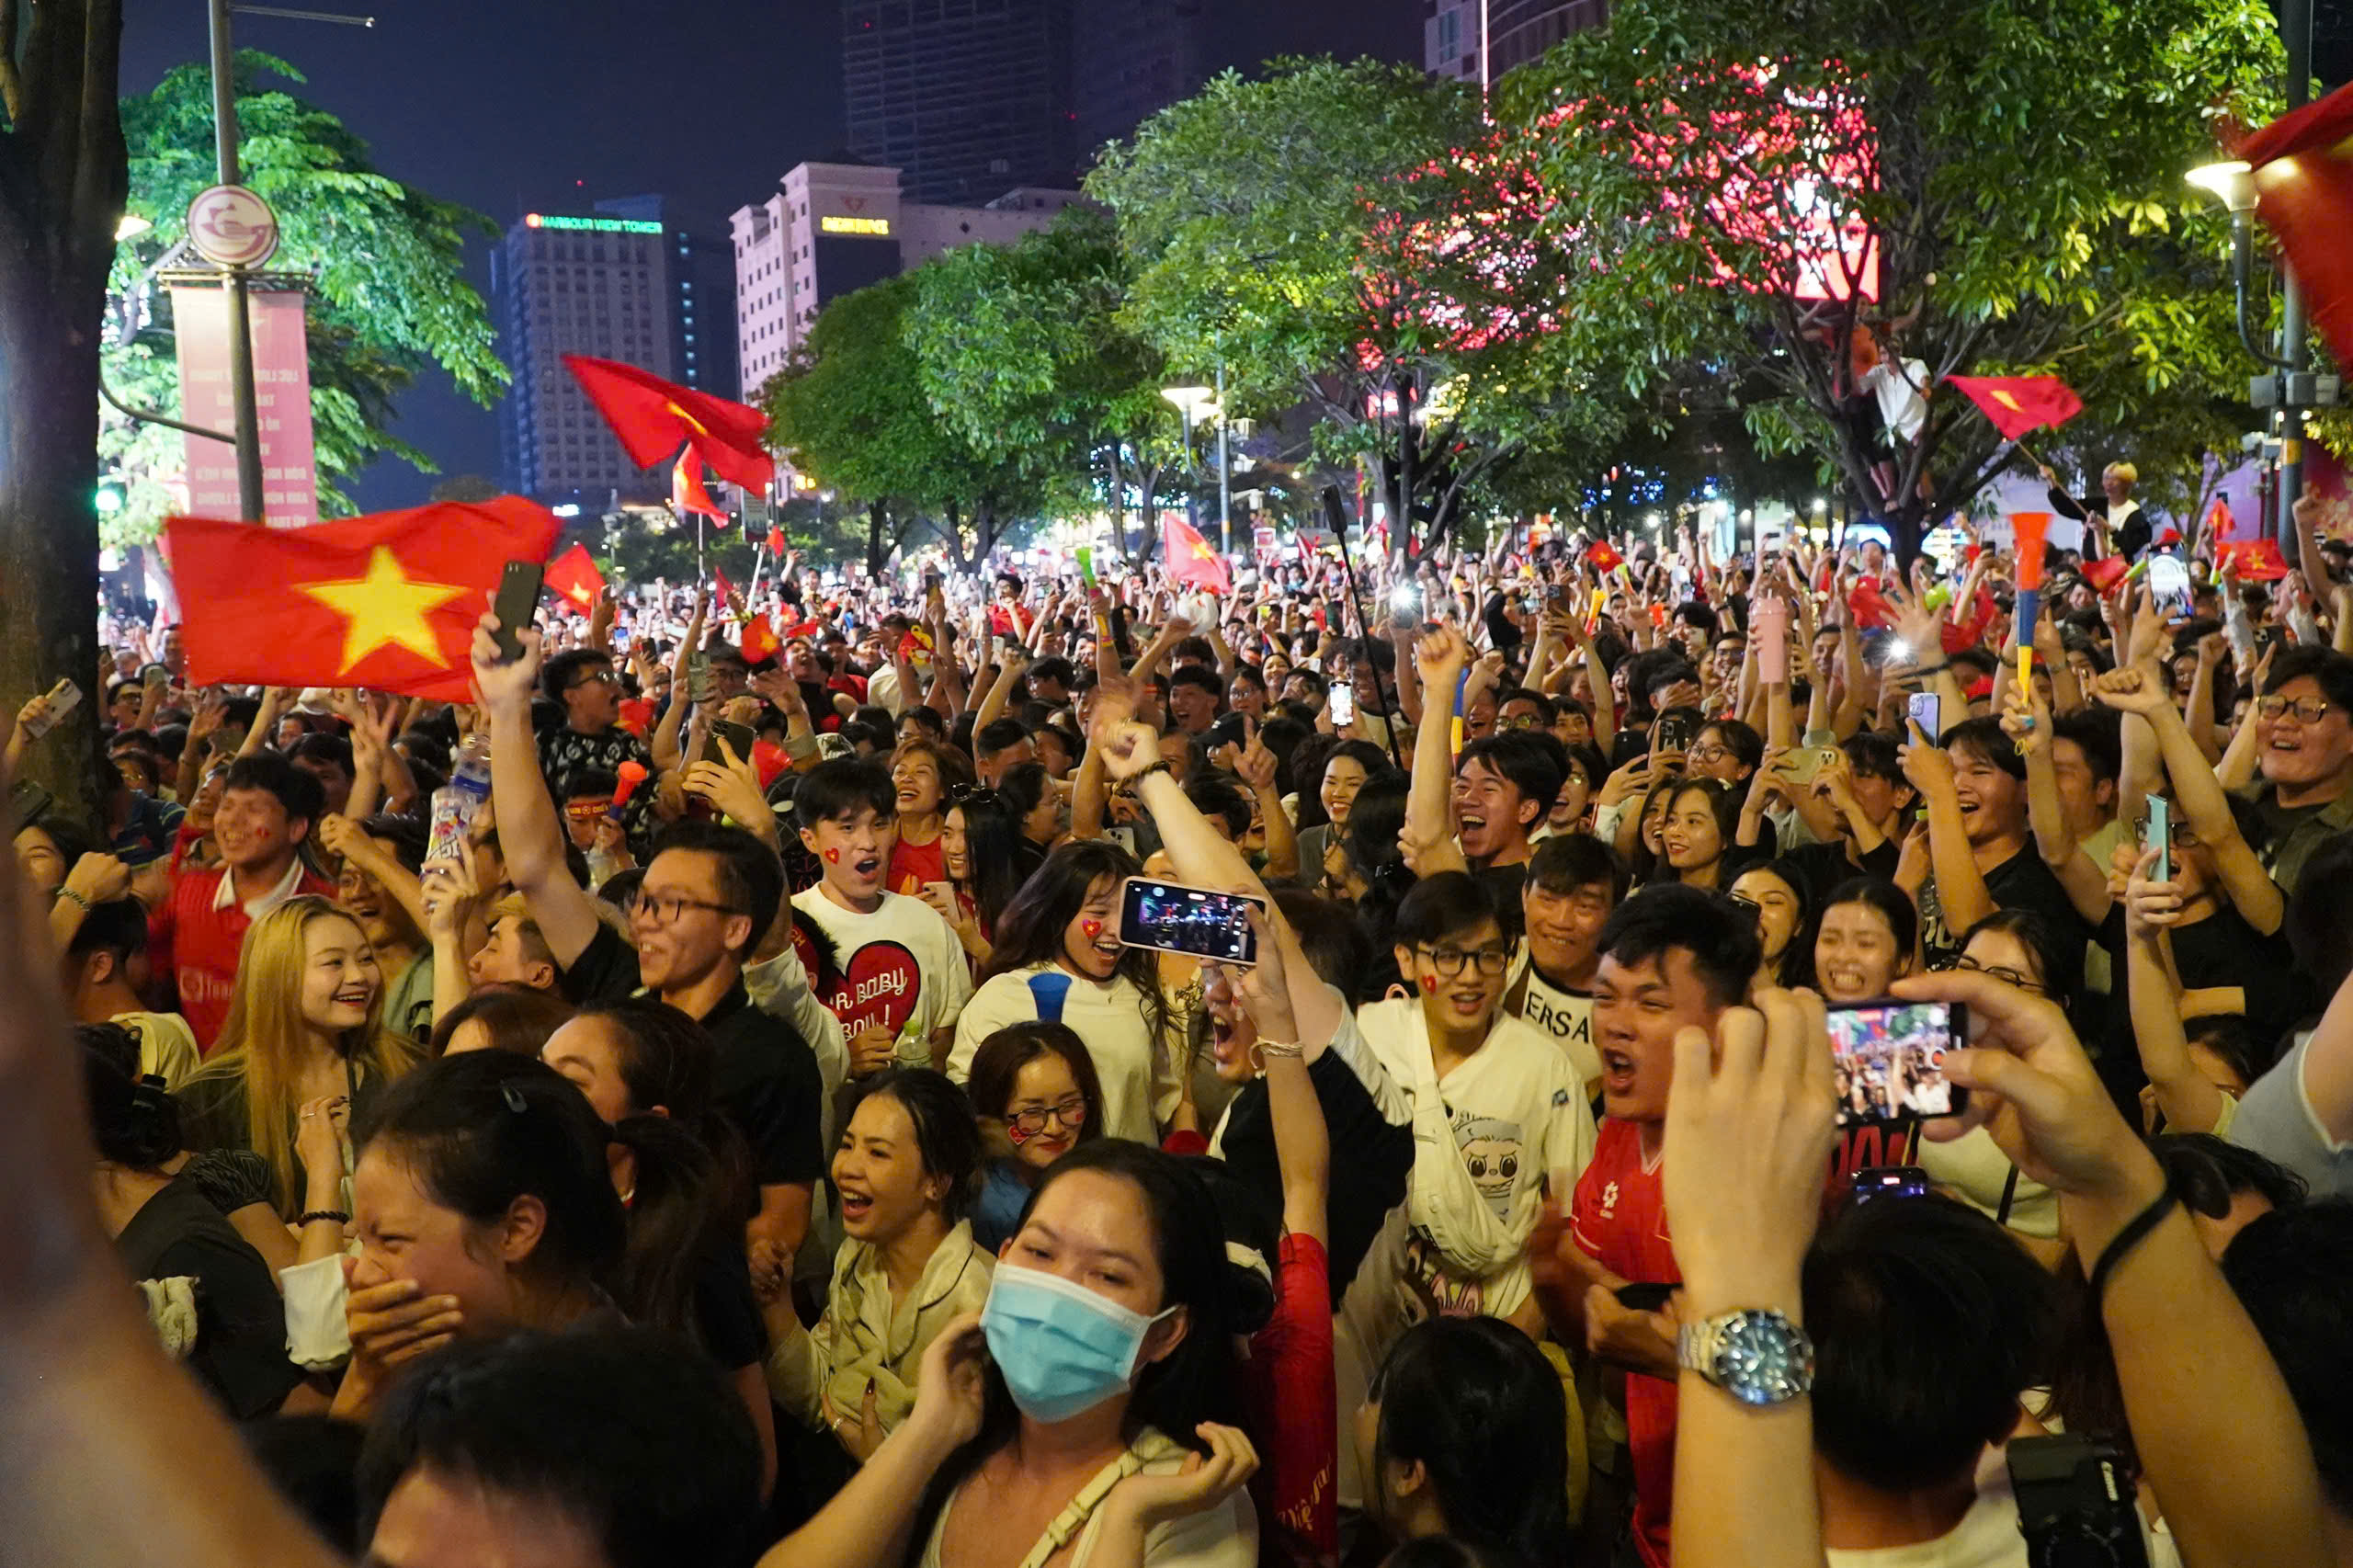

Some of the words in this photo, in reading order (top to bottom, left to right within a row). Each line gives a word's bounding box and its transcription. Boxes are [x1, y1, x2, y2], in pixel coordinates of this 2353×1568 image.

[540, 216, 594, 230] HARBOUR
[594, 219, 622, 232] VIEW
[622, 220, 663, 234] TOWER
[856, 967, 908, 1006] BABY
[1524, 991, 1590, 1045] ERSA
